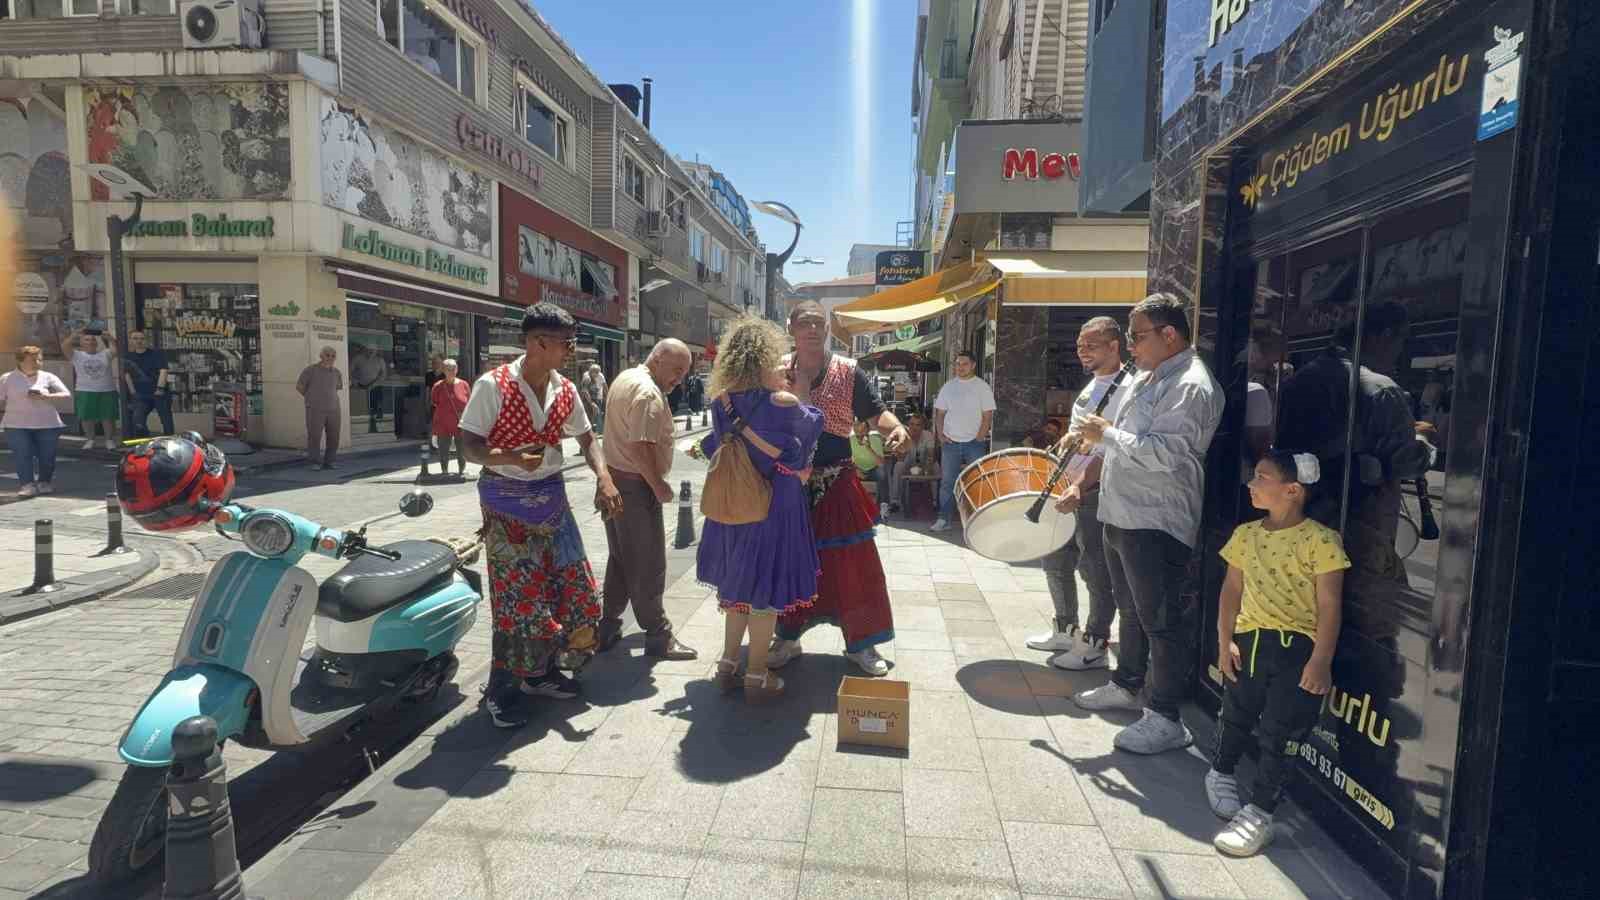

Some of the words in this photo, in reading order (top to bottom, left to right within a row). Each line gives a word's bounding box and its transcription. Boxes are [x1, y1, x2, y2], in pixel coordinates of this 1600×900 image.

[1208, 0, 1257, 48] Ha
[1269, 117, 1351, 197] Çiğdem
[1359, 52, 1470, 143] Uğurlu
[128, 217, 188, 237] kman
[191, 212, 275, 238] Baharat
[342, 222, 426, 268] Lokman
[1320, 685, 1391, 748] urlu
[1333, 767, 1347, 791] 67
